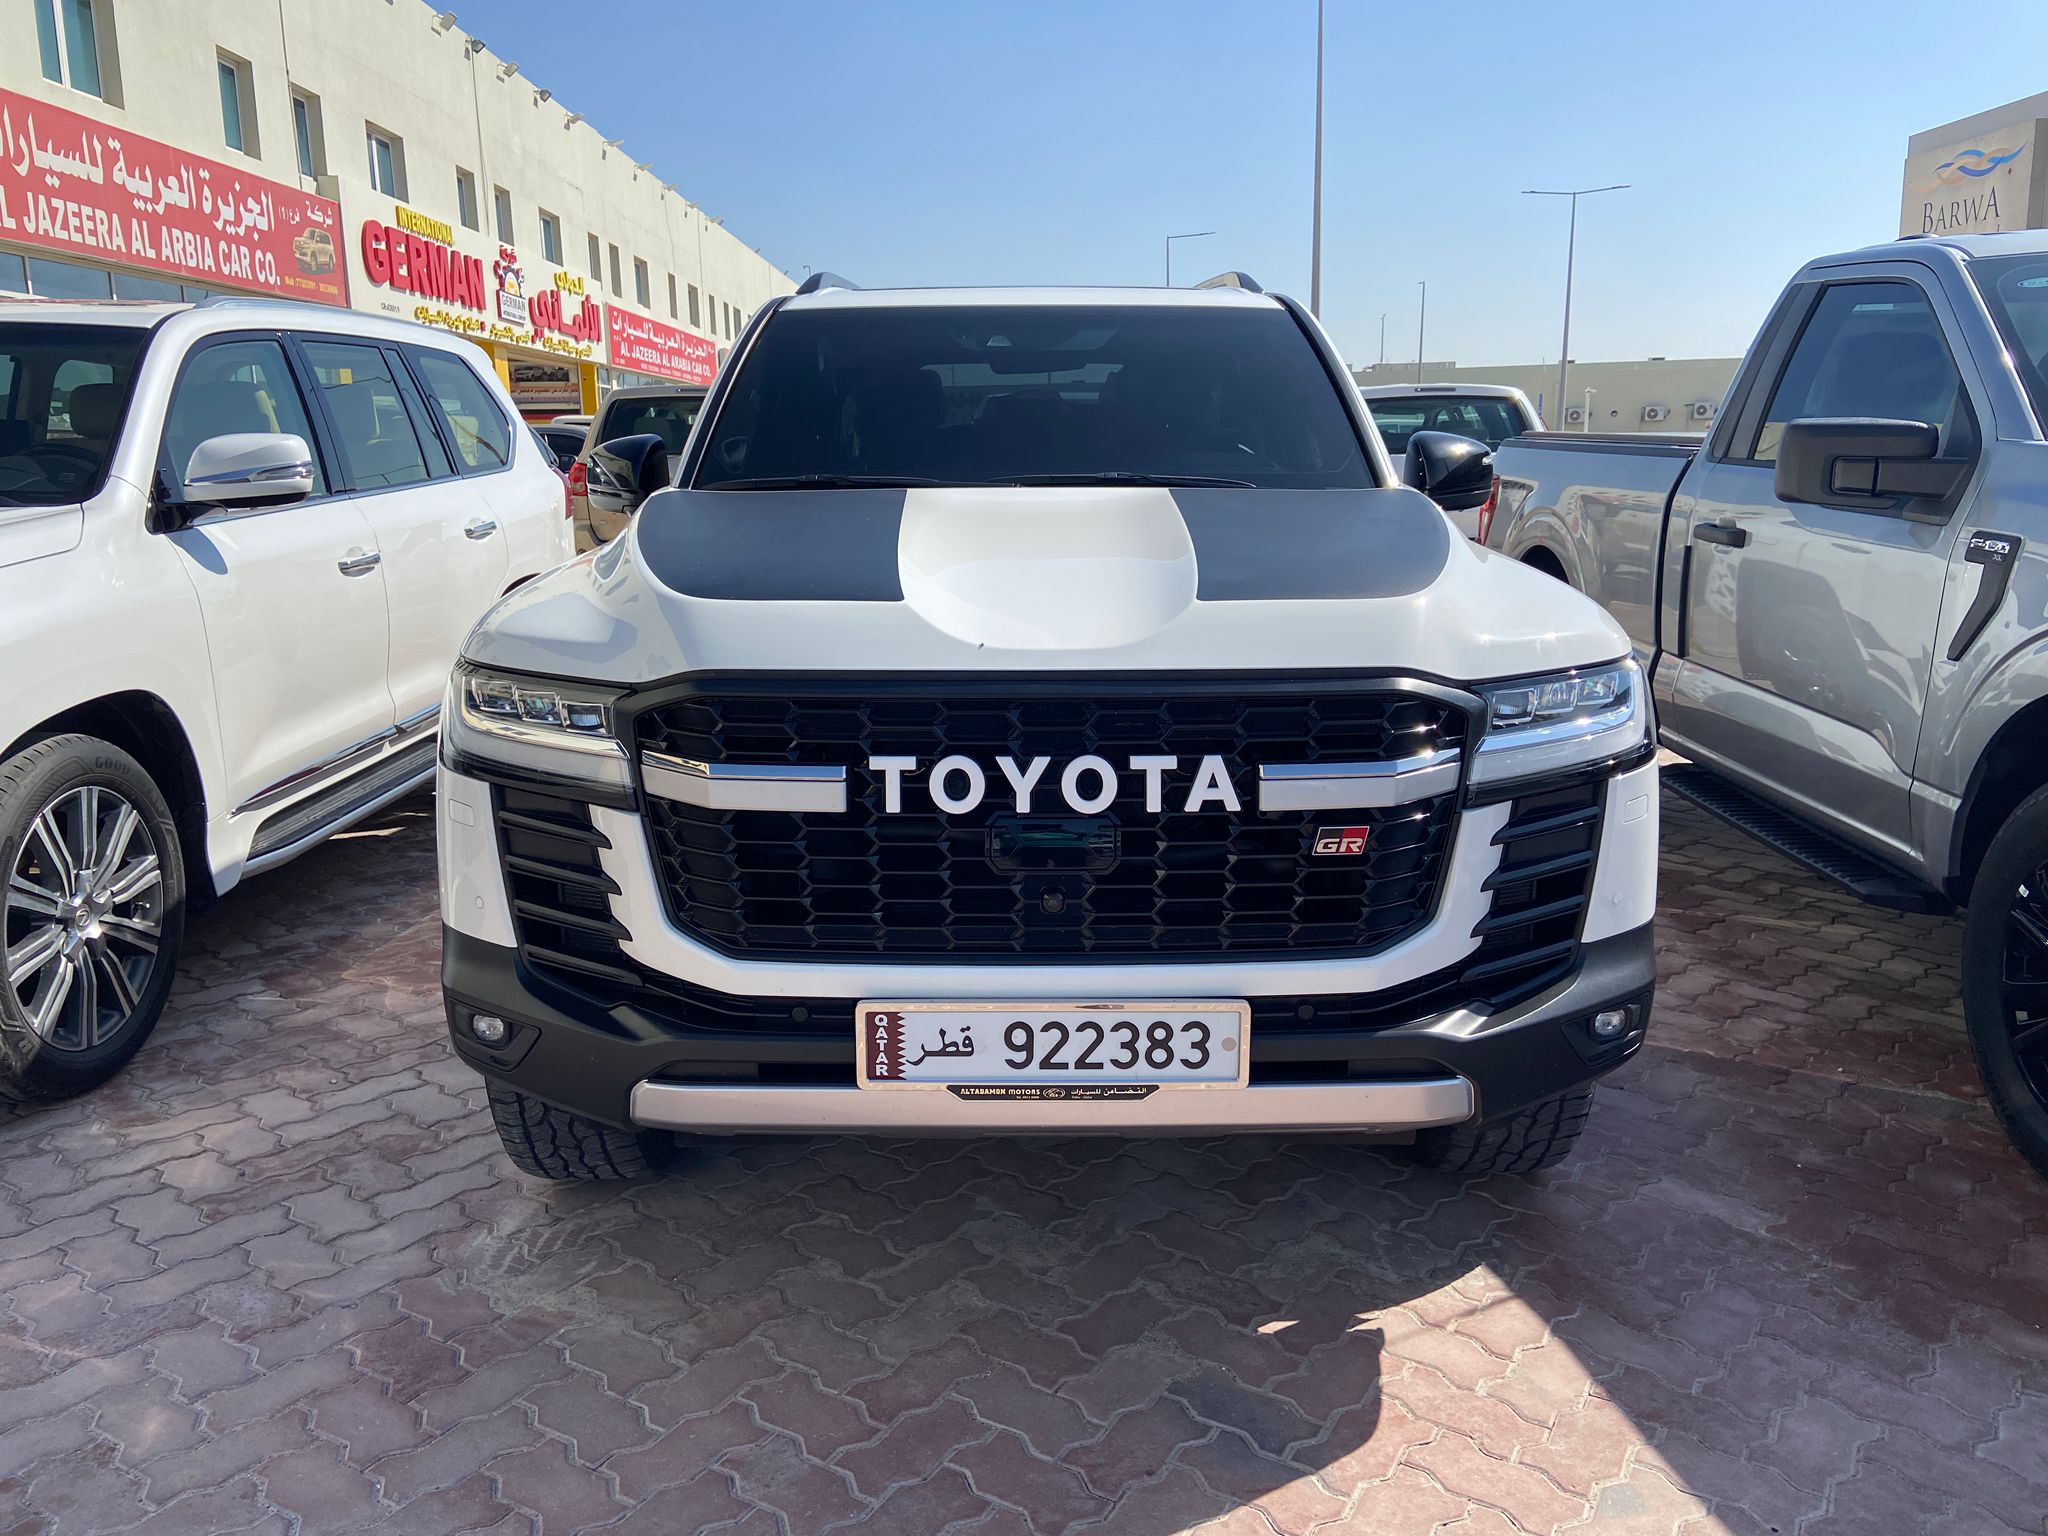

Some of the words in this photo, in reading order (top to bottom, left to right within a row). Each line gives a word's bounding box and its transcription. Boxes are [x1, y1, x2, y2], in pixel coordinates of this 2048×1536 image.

[0, 103, 104, 189] للسيارا
[107, 136, 196, 215] العربية
[199, 167, 275, 241] الجزيرة
[1922, 185, 2001, 234] BARWA
[0, 185, 17, 230] L
[23, 191, 126, 253] JAZEERA
[131, 217, 156, 260] AL
[161, 225, 216, 273] ARBIA
[218, 240, 253, 281] CAR
[254, 249, 281, 287] CO.
[395, 205, 454, 244] INTERNATIONAL
[361, 219, 487, 311] GERMAN
[502, 294, 526, 312] GERMAN
[612, 311, 649, 341] للسيارات
[648, 322, 681, 350] العربية
[621, 341, 631, 357] AL
[631, 345, 661, 364] JAZEERA
[662, 353, 671, 367] AL
[671, 355, 692, 373] ARABIA
[692, 361, 702, 376] CAR
[681, 333, 708, 360] الجزيرة
[868, 754, 1242, 815] TOYOTA
[1316, 837, 1364, 853] GR
[874, 1014, 889, 1076] QATAR
[905, 1026, 975, 1066] قطر
[1003, 1020, 1211, 1071] 922383
[960, 1087, 1006, 1095] ALTADAMON
[1070, 1088, 1101, 1096] للسيارات
[1103, 1087, 1147, 1096] التضامن
